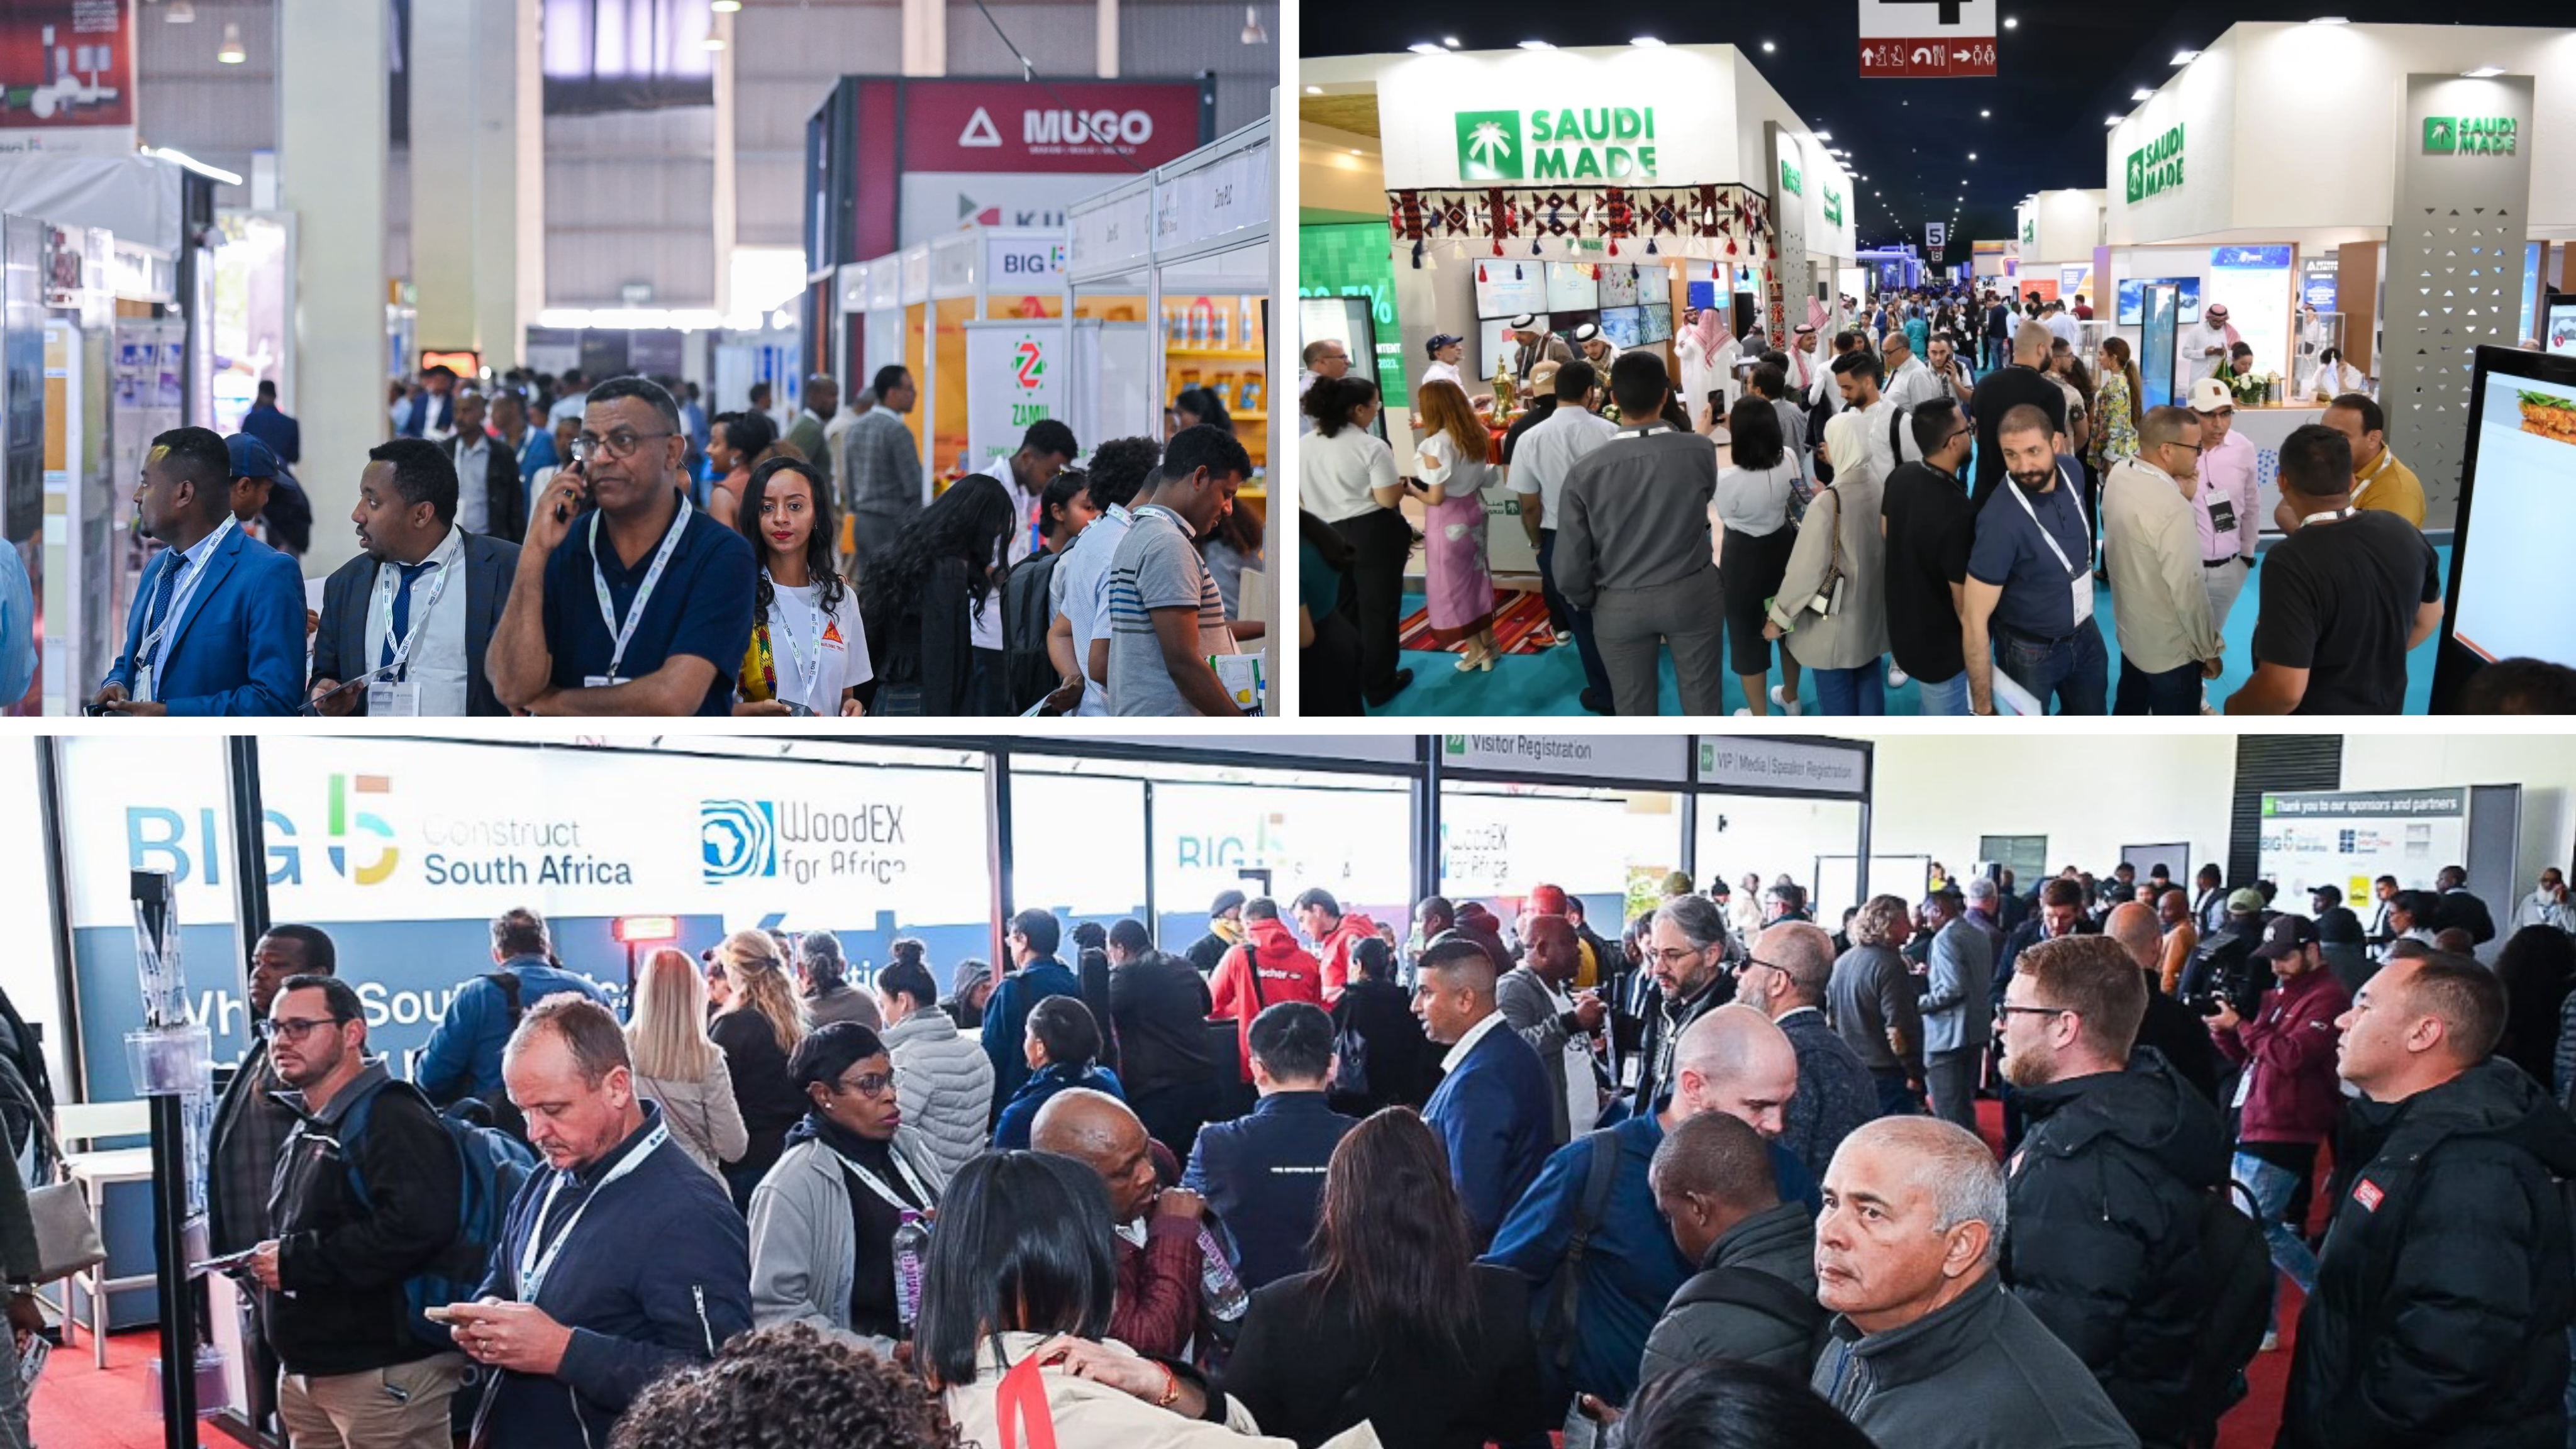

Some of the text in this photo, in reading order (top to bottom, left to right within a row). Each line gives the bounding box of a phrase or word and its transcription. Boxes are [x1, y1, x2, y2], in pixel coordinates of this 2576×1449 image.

[1023, 109, 1153, 144] MUGO
[1531, 107, 1654, 142] SAUDI
[2460, 117, 2516, 135] SAUDI
[2146, 121, 2184, 168] SAUDI
[2460, 135, 2516, 152] MADE
[1533, 147, 1657, 179] MADE
[2145, 157, 2184, 197] MADE
[1929, 228, 1941, 245] 5
[1004, 254, 1045, 273] BIG
[210, 538, 219, 547] BIG
[824, 626, 841, 641] Sika
[1472, 735, 1592, 760] Visitor Registration
[1718, 753, 1732, 770] VIP
[1740, 754, 1767, 773] Media
[1772, 757, 1805, 777] Speaker
[1806, 760, 1852, 780] Registration
[2275, 797, 2458, 814] Thank you to our sponsors and partners
[423, 817, 580, 847] Construct
[780, 801, 906, 845] WoodEX
[126, 806, 302, 886] BIG
[425, 853, 633, 884] South Africa
[783, 850, 819, 884] for
[358, 982, 462, 1028] Sou
